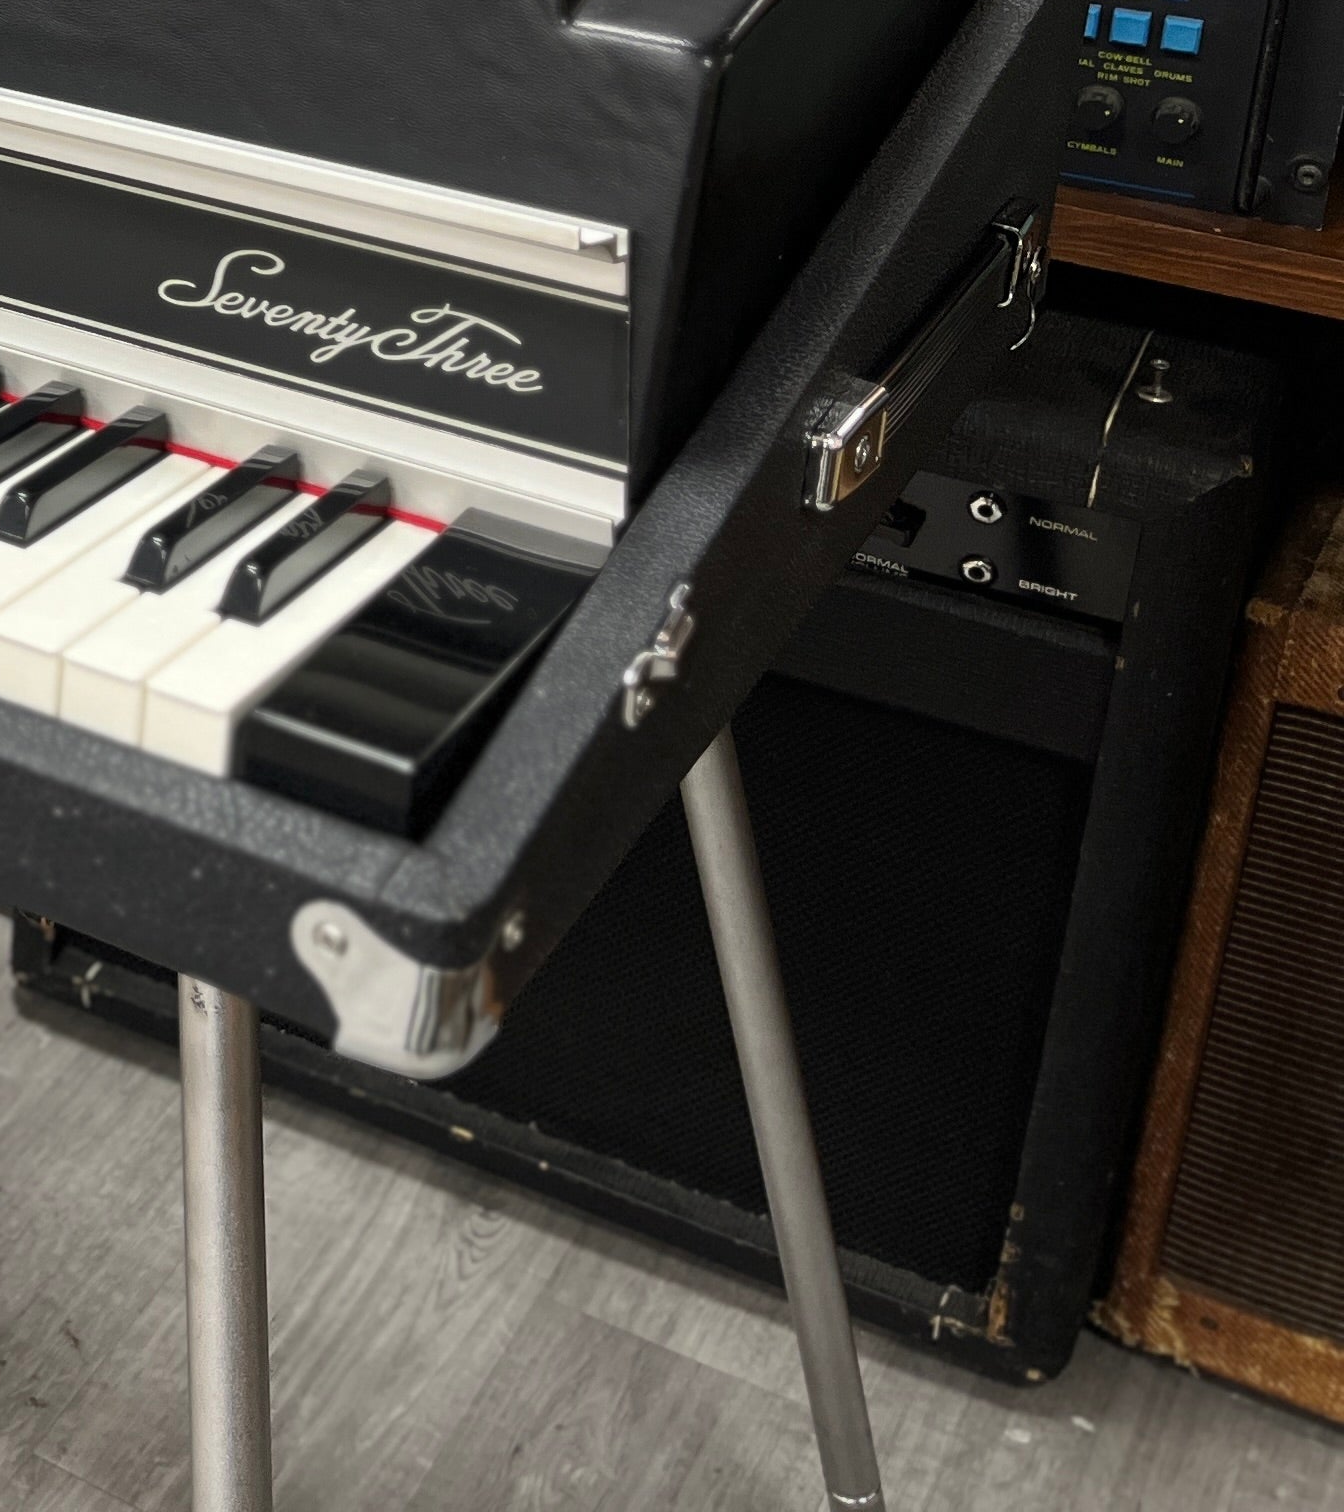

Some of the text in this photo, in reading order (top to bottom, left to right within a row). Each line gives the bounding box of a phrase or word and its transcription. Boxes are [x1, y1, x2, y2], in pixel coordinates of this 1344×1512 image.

[1098, 51, 1152, 66] COW BELL
[1103, 62, 1144, 75] CLAVES
[1123, 77, 1151, 86] SHOT
[1154, 70, 1193, 83] DRUMS
[1156, 156, 1184, 167] MAIN
[157, 249, 543, 392] Seventy Three
[1030, 516, 1098, 542] NORMAL
[852, 552, 909, 574] ORMAL
[1019, 579, 1079, 601] BRIGHT
